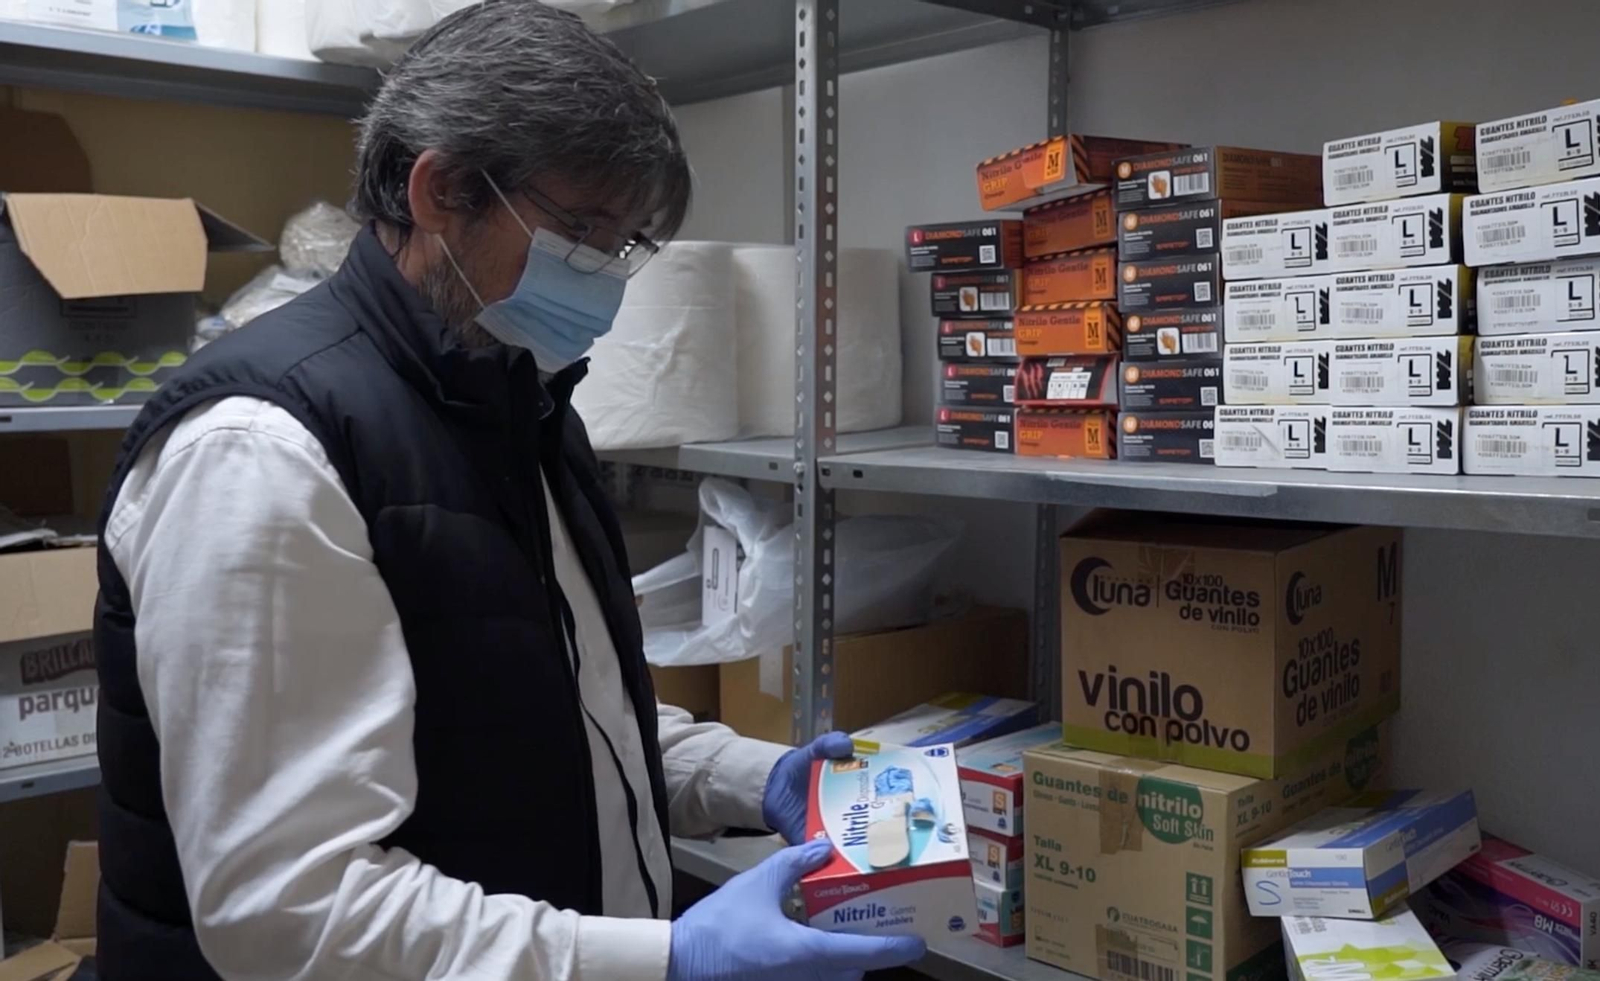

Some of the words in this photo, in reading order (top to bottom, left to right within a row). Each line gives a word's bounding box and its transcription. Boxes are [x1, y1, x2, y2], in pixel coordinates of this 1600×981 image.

[1480, 122, 1515, 136] GUANTES
[1516, 115, 1547, 128] NITRILO
[1565, 128, 1580, 149] L
[1047, 151, 1060, 170] M
[1192, 153, 1208, 164] 061
[1395, 150, 1406, 168] L
[1470, 196, 1504, 208] GUANTES
[1505, 192, 1536, 204] NITRILO
[1094, 210, 1107, 228] M
[1138, 211, 1198, 225] DIAMONDSAFE
[1199, 208, 1215, 219] 061
[1333, 208, 1362, 219] GUANTES
[1363, 205, 1389, 216] NITRILO
[1552, 206, 1567, 226] L
[1402, 219, 1415, 238] L
[1291, 232, 1302, 250] L
[1094, 267, 1107, 285] M
[1138, 264, 1196, 277] DIAMONDSAFE
[1196, 262, 1212, 272] 061
[1336, 276, 1366, 285] GUANTES
[1367, 273, 1395, 284] NITRILO
[1409, 289, 1422, 307] L
[1568, 281, 1582, 300] L
[1018, 317, 1048, 327] Nitrilo
[1049, 315, 1082, 326] Gentle
[1142, 314, 1200, 326] DIAMONDSAFE
[1201, 313, 1217, 323] 061
[1018, 327, 1042, 339] GRIP
[1086, 321, 1100, 339] M
[1335, 344, 1366, 353] GUANTES
[1367, 343, 1394, 351] NITRILO
[1480, 340, 1515, 349] GUANTES
[1516, 338, 1547, 348] NITRILO
[1142, 368, 1202, 379] DIAMONDSAFE
[1203, 368, 1219, 378] 061
[1294, 360, 1304, 378] L
[1409, 359, 1421, 377] L
[1332, 411, 1364, 419] GUANTES
[1365, 410, 1393, 419] NITRILO
[1469, 410, 1505, 419] GUANTES
[1506, 409, 1538, 419] NITRILO
[1139, 419, 1201, 430] DIAMONDSAFE
[1289, 424, 1300, 441] L
[1086, 427, 1100, 445] M
[1408, 427, 1421, 446] L
[1555, 427, 1569, 447] L
[1182, 573, 1223, 587] 10x100
[1377, 542, 1397, 602] M
[1164, 579, 1260, 607] Guantes
[1179, 603, 1203, 622] de
[1207, 607, 1260, 627] vinilo
[1298, 626, 1334, 659] 10x100
[1283, 638, 1360, 698] Guantes
[1078, 665, 1203, 721] vinilo
[1296, 694, 1320, 727] de
[1321, 672, 1360, 716] vinilo
[1104, 711, 1156, 736] con
[1165, 717, 1250, 752] polvo
[994, 790, 1007, 809] S
[1033, 771, 1102, 799] Guantes
[1107, 788, 1128, 804] de
[1138, 791, 1202, 819] nitrilo
[842, 803, 869, 847] Nitrile
[1153, 813, 1180, 836] Soft
[1184, 820, 1214, 843] Skin
[1033, 834, 1062, 852] Talla
[989, 845, 1000, 862] S
[1033, 852, 1054, 872] XL
[1060, 861, 1097, 884] 9-10
[1256, 880, 1281, 906] S
[833, 903, 886, 924] Nitrile
